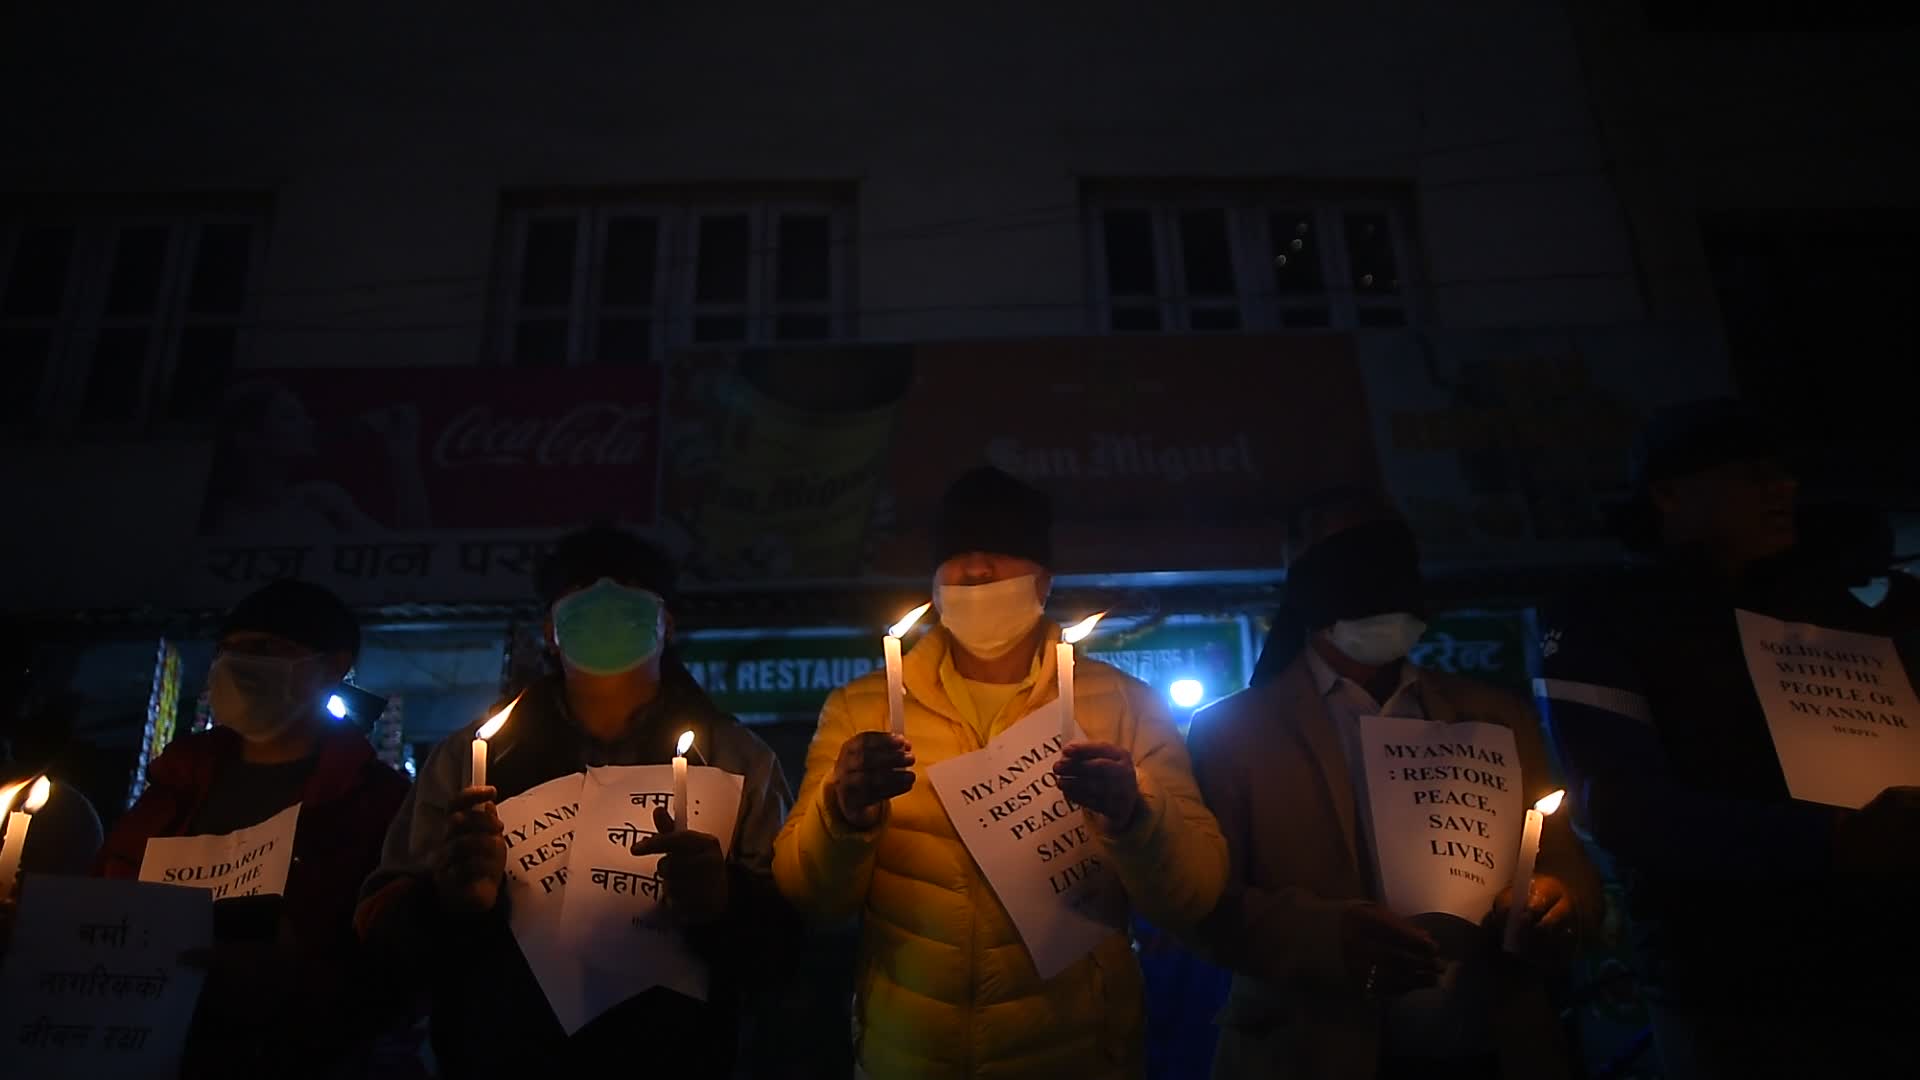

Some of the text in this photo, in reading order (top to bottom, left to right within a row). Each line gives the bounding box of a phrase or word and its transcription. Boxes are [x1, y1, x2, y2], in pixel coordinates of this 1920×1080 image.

[1088, 431, 1262, 482] Miguel
[332, 541, 436, 578] पान
[1760, 639, 1884, 668] SOLIDARITY
[683, 659, 728, 692] AK
[1776, 661, 1886, 686] WITH THE
[1780, 680, 1897, 707] PEOPLE OF
[1789, 700, 1909, 729] MYANMAR
[1384, 743, 1506, 767] MYANMAR
[1403, 766, 1508, 793] RESTORE
[988, 771, 1059, 822] RESTO
[1414, 789, 1497, 816] PEACE,
[1429, 814, 1490, 839] SAVE
[1037, 825, 1091, 863] SAVE
[1430, 840, 1495, 870] LIVES
[163, 837, 279, 882] SOLIDARITY
[233, 864, 263, 889] THE
[1049, 855, 1101, 894] LIVES
